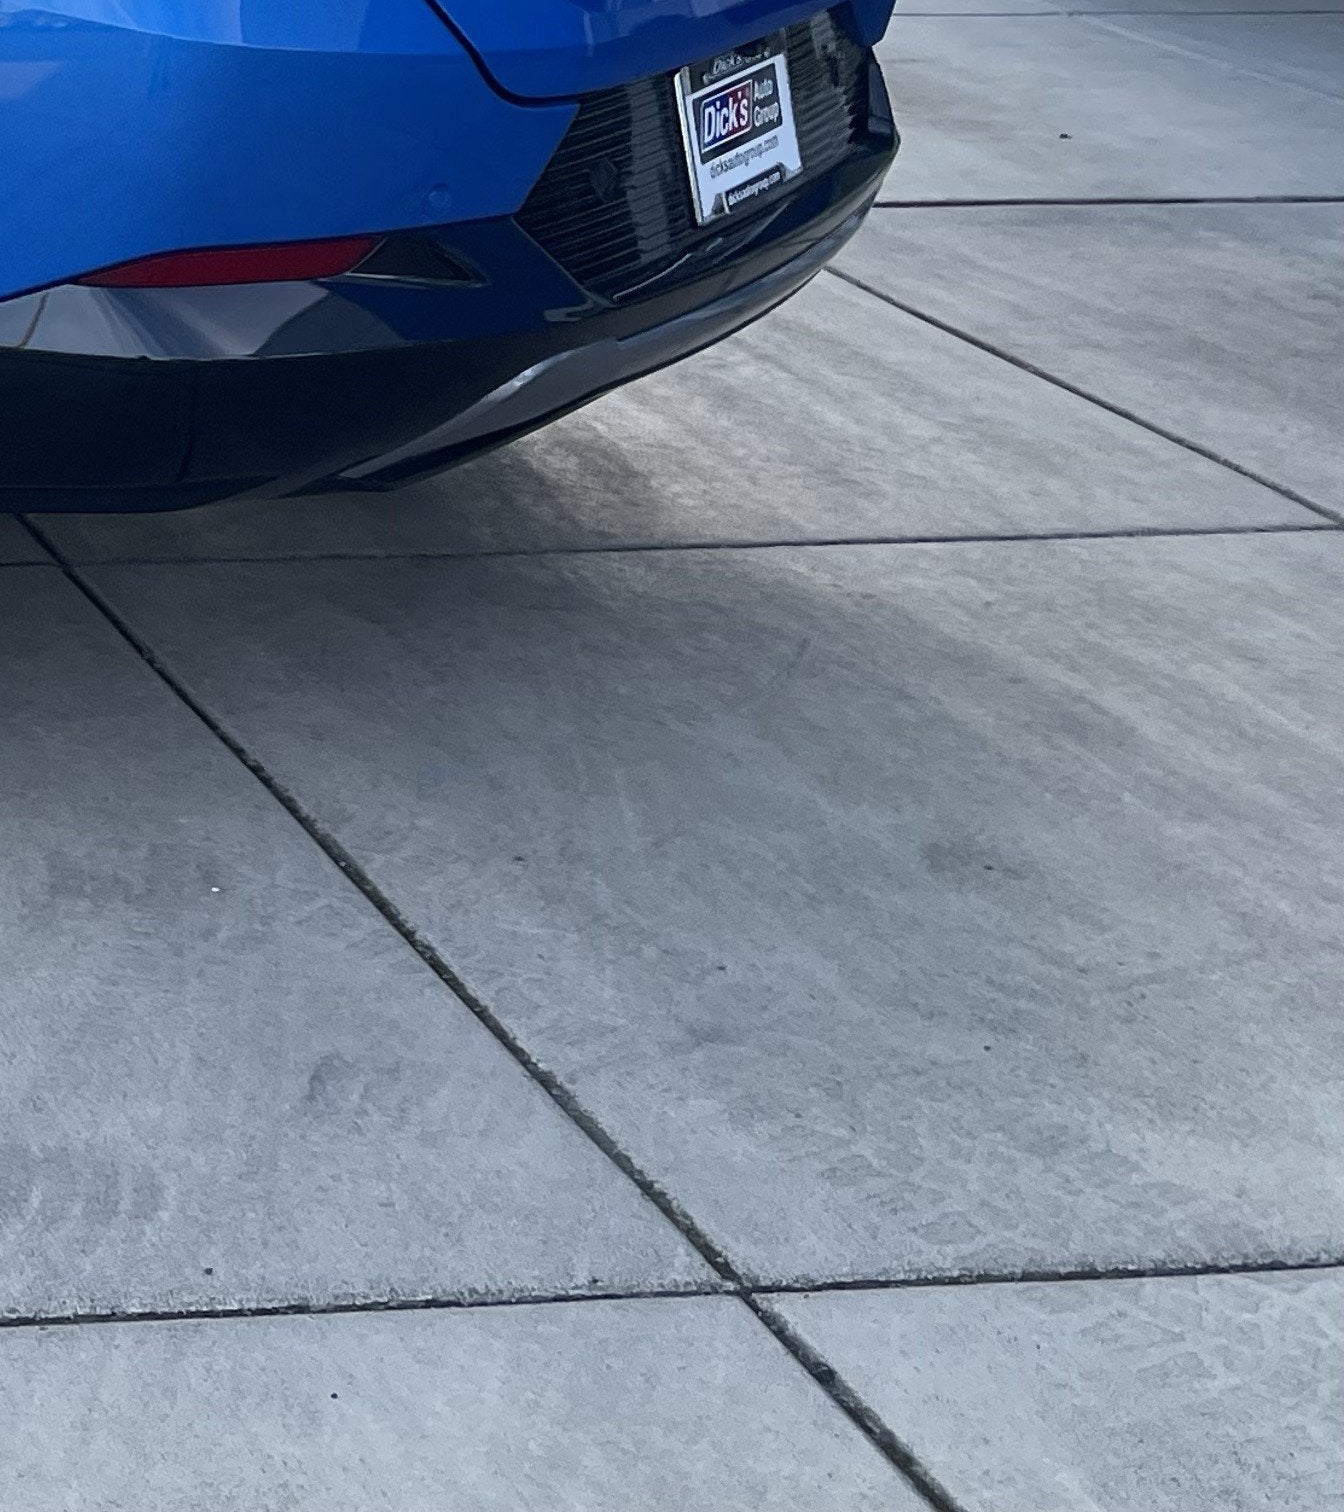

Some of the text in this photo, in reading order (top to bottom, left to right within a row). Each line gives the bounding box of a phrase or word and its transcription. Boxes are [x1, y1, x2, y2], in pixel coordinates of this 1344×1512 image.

[703, 78, 774, 144] Dick's Auto
[753, 102, 780, 128] Group
